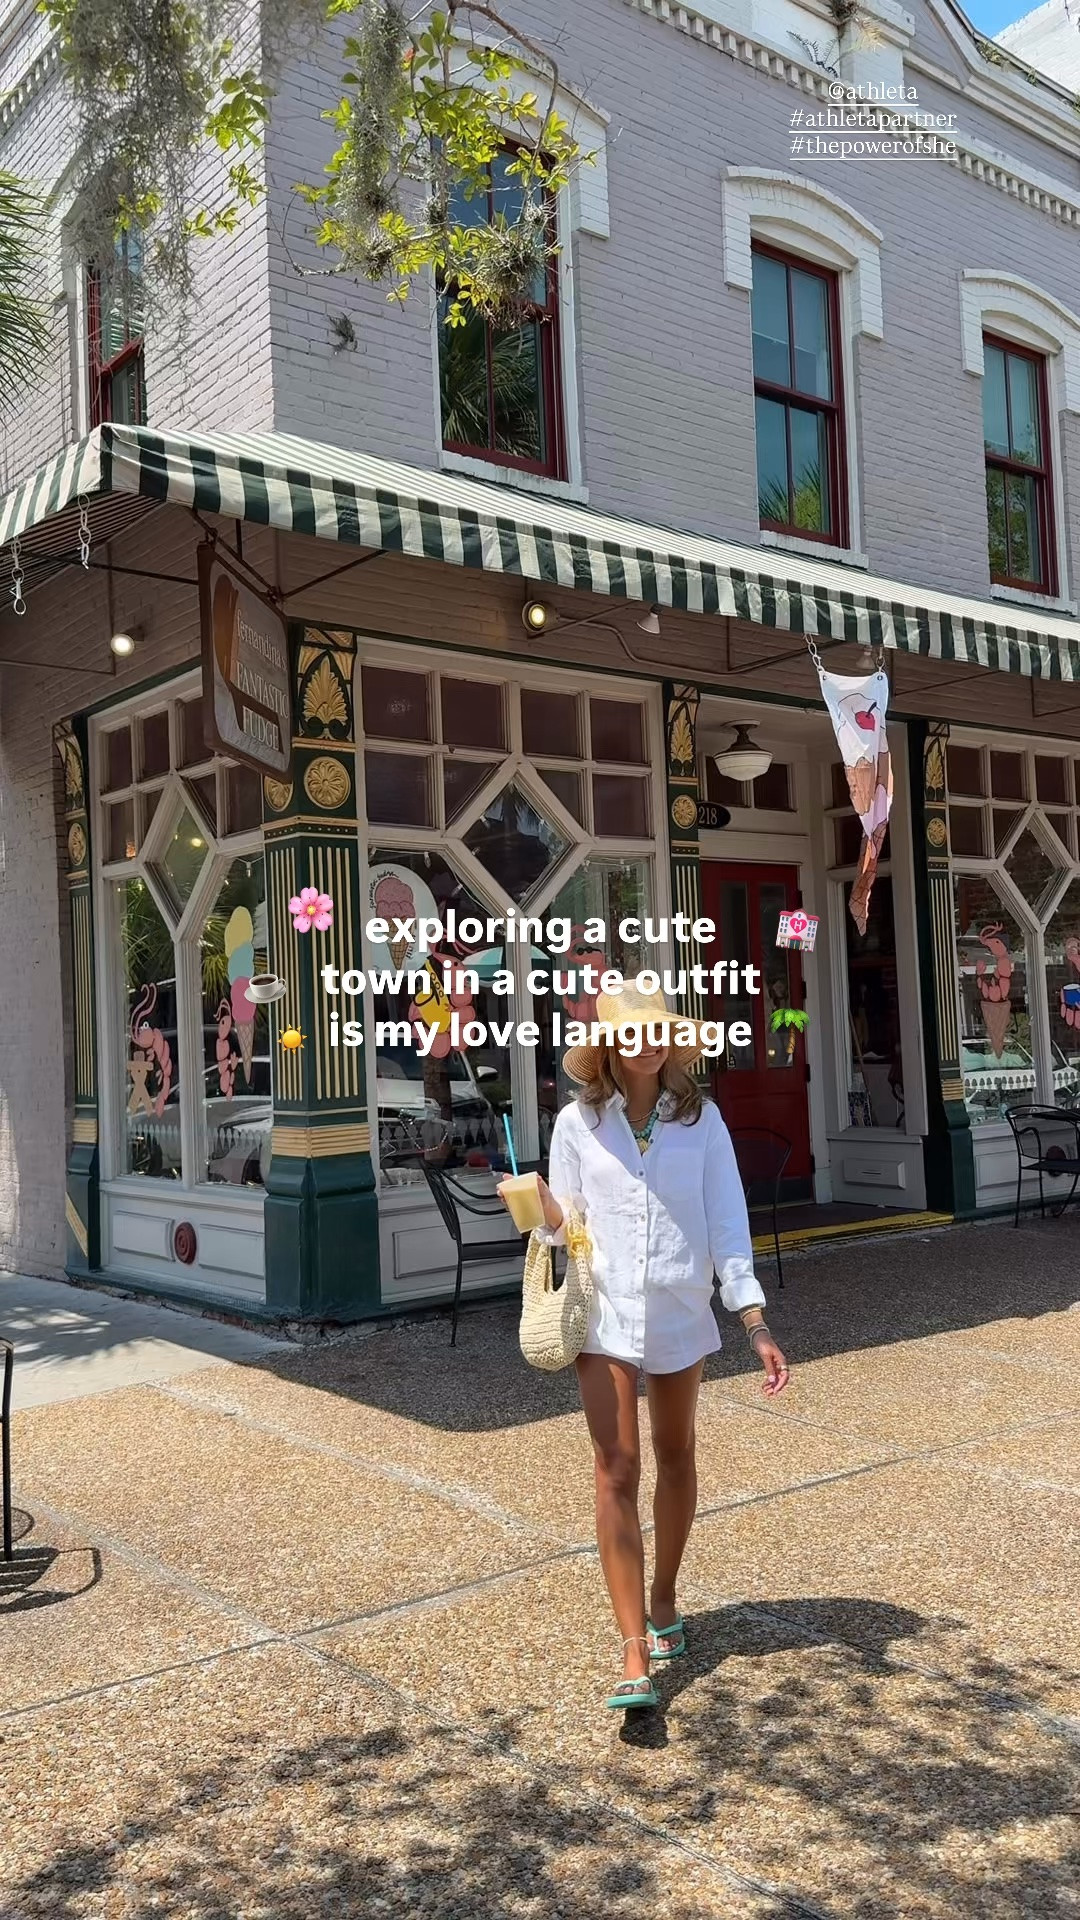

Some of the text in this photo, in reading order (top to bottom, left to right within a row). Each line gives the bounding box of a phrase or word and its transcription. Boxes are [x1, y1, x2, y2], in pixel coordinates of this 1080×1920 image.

[235, 660, 289, 719] FANTASTIC
[242, 705, 280, 751] FUDGE
[698, 806, 718, 825] 218
